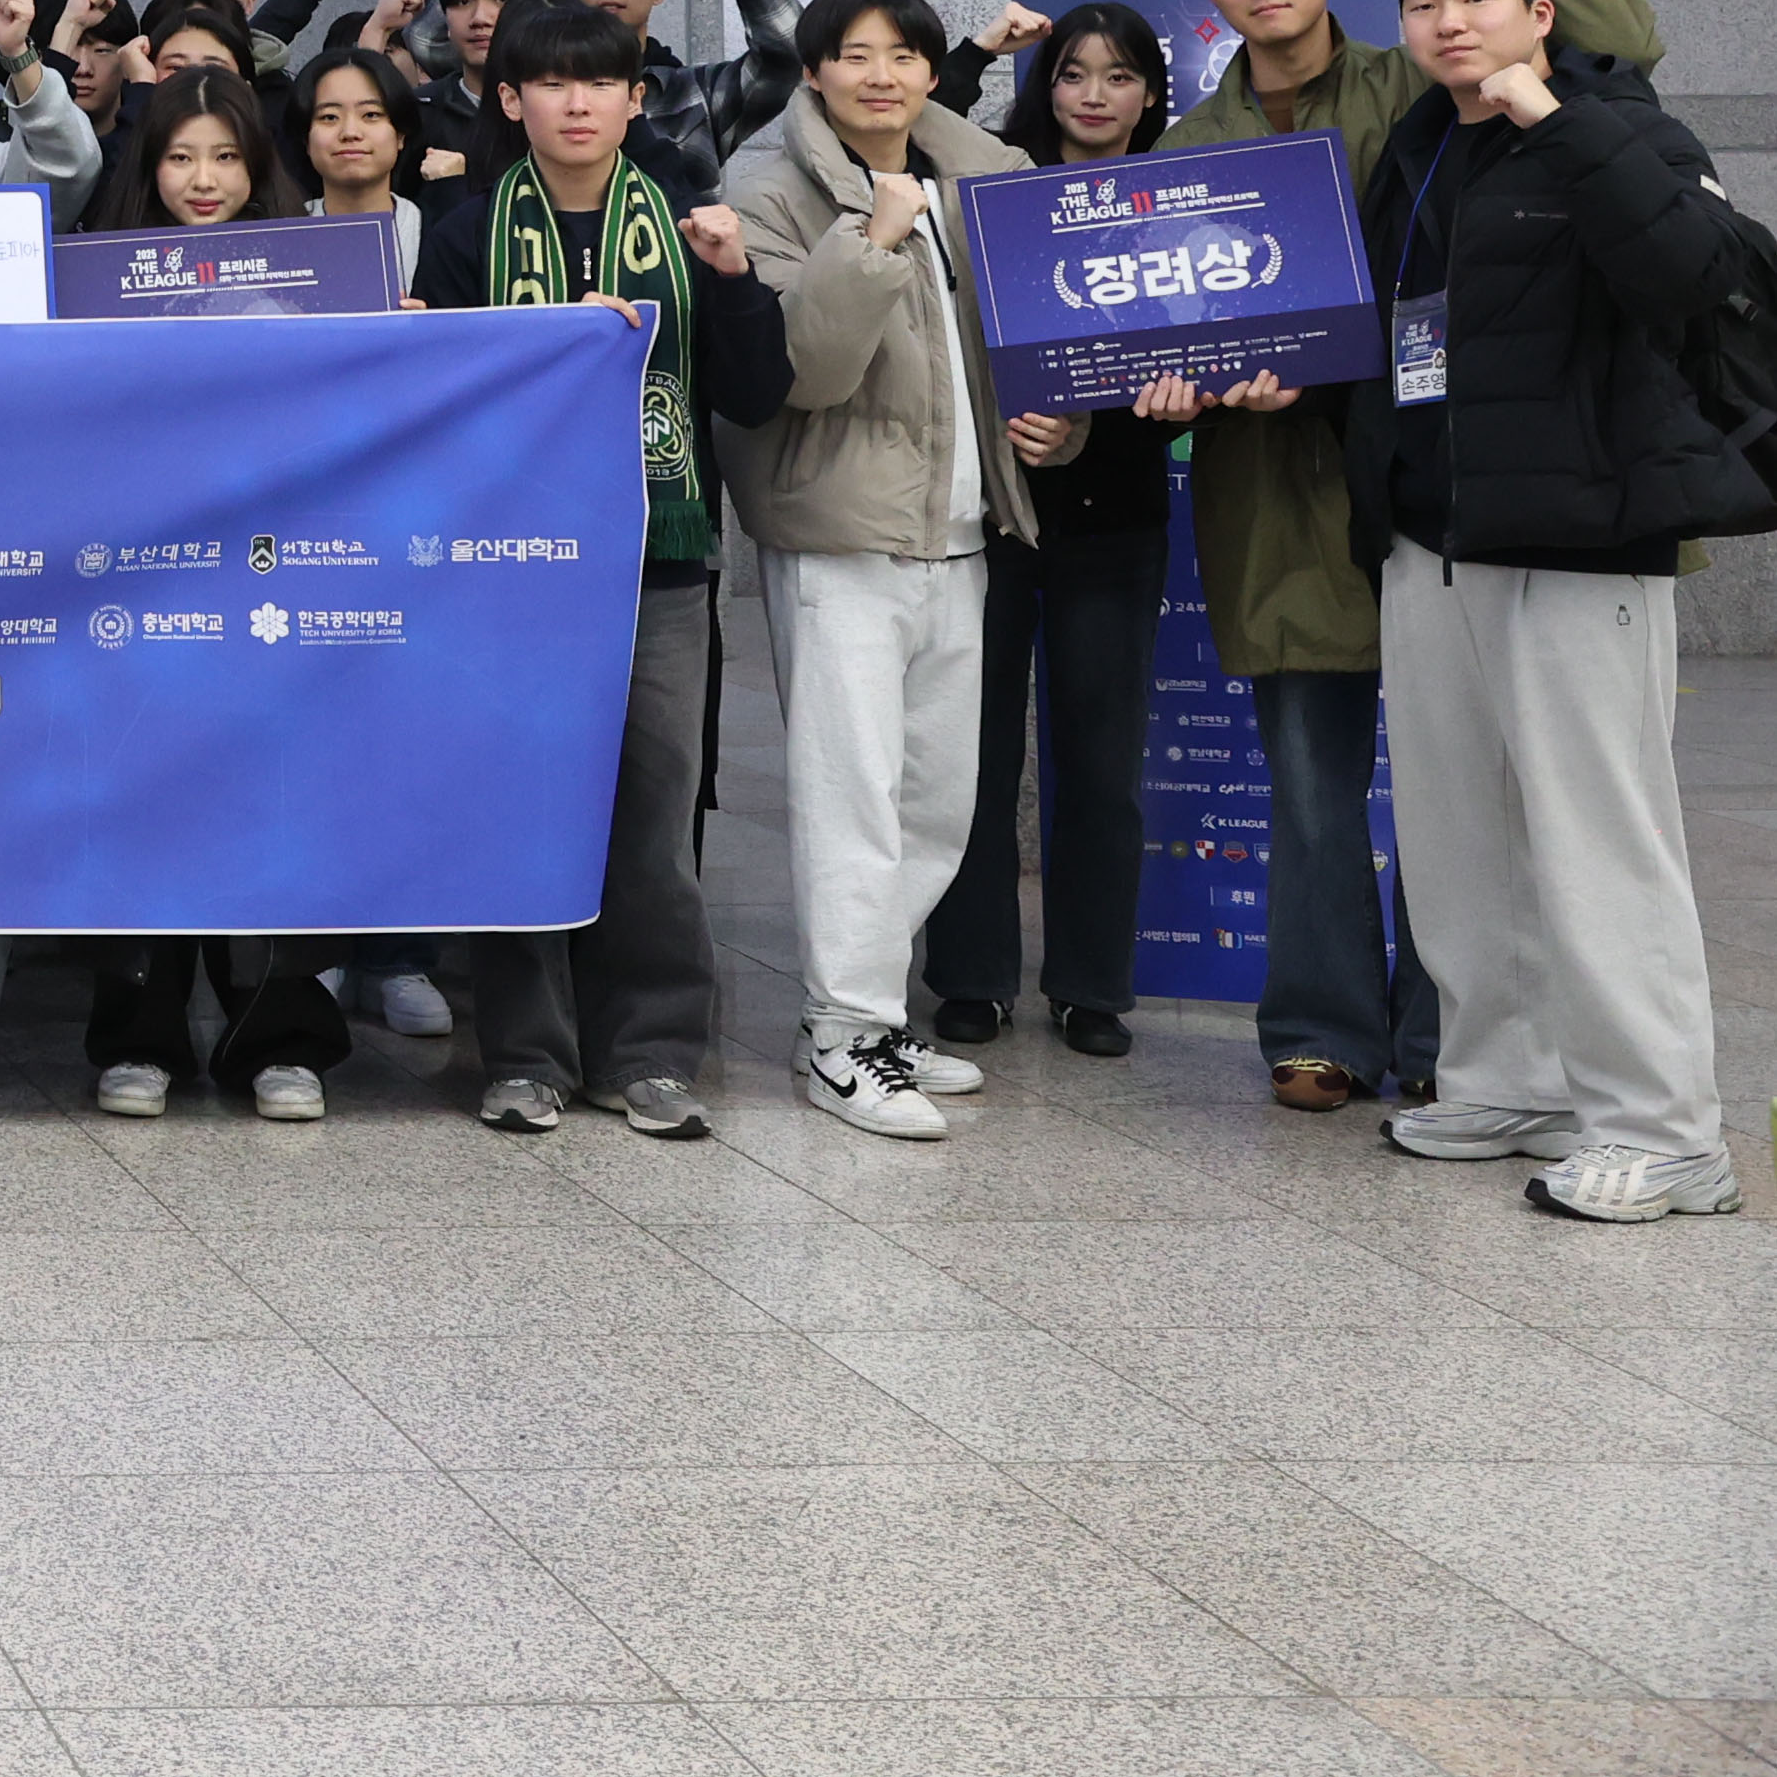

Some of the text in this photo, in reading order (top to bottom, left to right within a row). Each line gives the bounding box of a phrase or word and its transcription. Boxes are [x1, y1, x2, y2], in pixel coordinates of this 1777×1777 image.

[1064, 181, 1087, 194] 2025
[1155, 184, 1208, 201] 프리시즌
[1050, 211, 1064, 225] K
[1066, 202, 1133, 223] LEAGUE
[1131, 191, 1153, 213] 11
[1057, 194, 1090, 209] THE
[136, 249, 156, 260] 2025
[129, 261, 158, 275] THE
[219, 258, 268, 273] 프리시즌
[1083, 239, 1252, 306] 장려상
[121, 277, 133, 291] K
[136, 272, 197, 289] LEAGUE
[197, 263, 215, 284] 11
[1402, 373, 1446, 395] 손주영
[117, 541, 222, 564] 부산대학교
[282, 539, 366, 556] 서강대학교
[450, 537, 579, 562] 울산대학교
[141, 562, 177, 571] NATIONAL
[143, 612, 223, 632] 충남대학교
[298, 610, 403, 628] 한국공학대학교
[300, 629, 320, 637] TECH
[378, 628, 402, 636] KOREA
[1231, 890, 1255, 905] 후원
